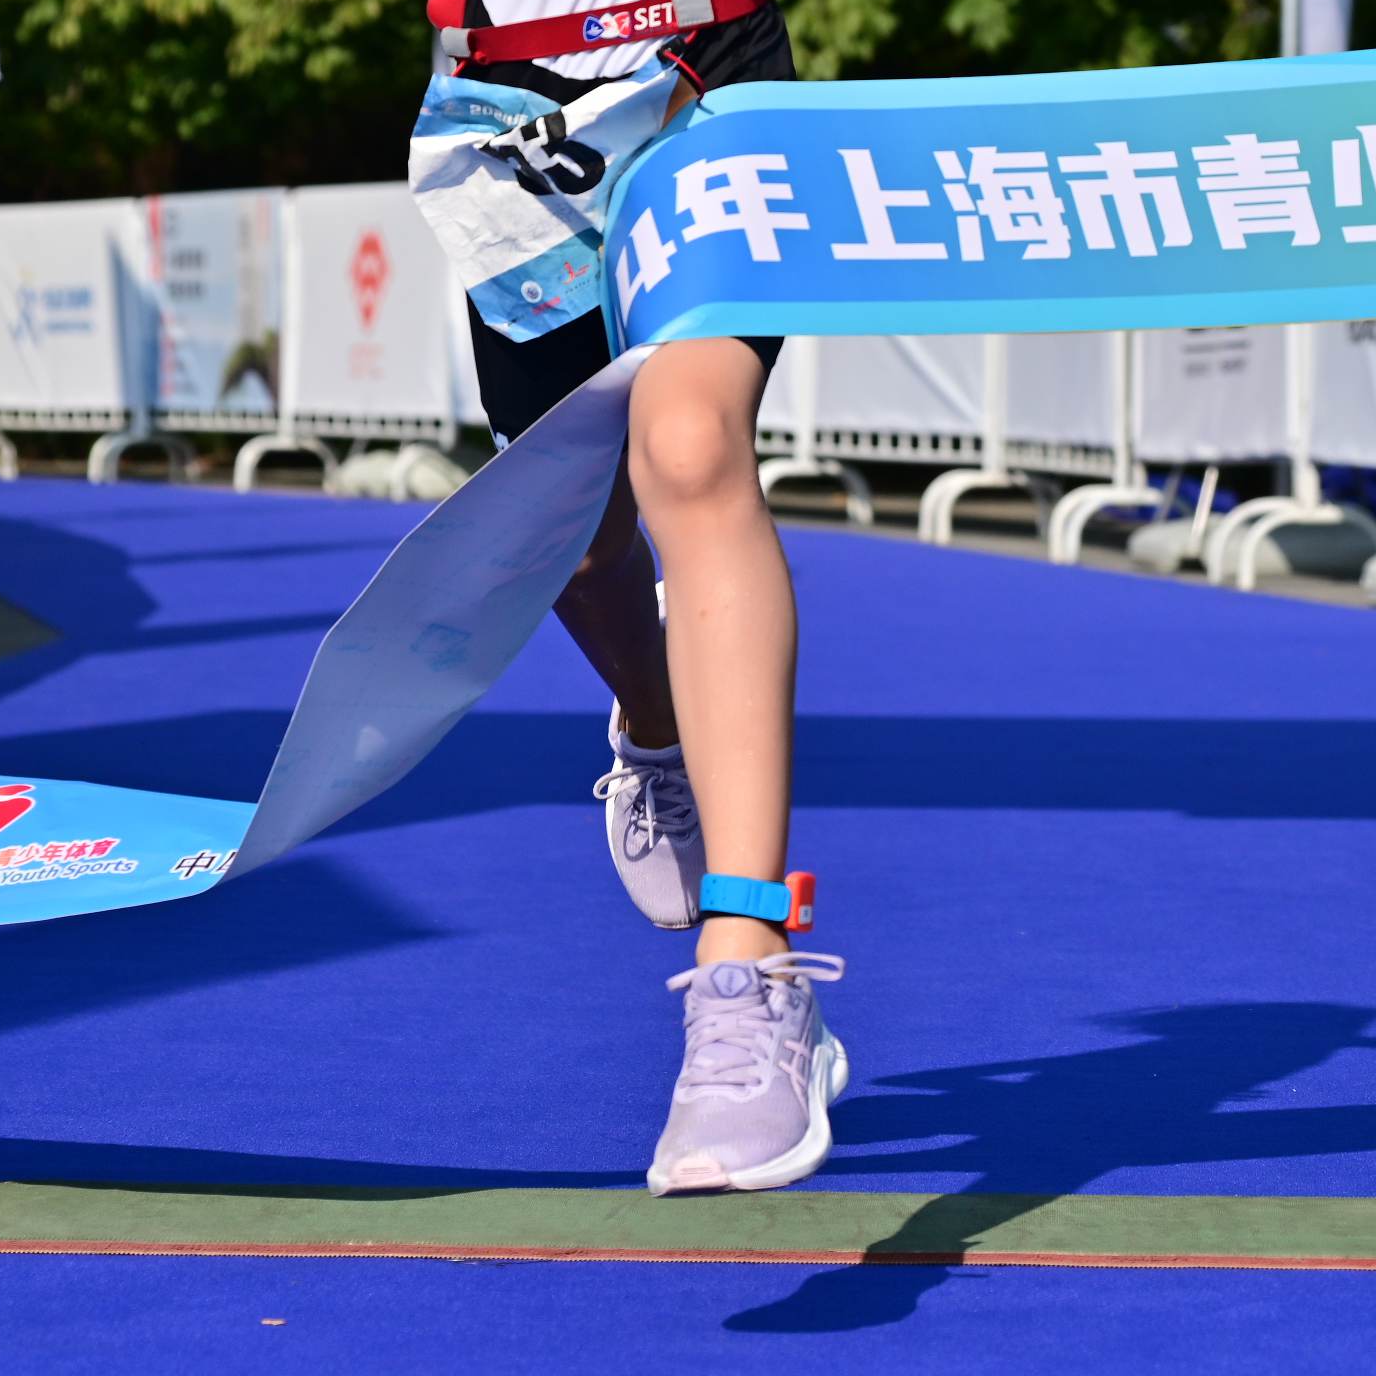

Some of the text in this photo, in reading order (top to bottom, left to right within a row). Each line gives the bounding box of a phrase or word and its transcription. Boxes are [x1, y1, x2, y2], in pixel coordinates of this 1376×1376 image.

[1, 864, 60, 884] Youth
[65, 859, 135, 879] Sports
[175, 852, 236, 878] 中
